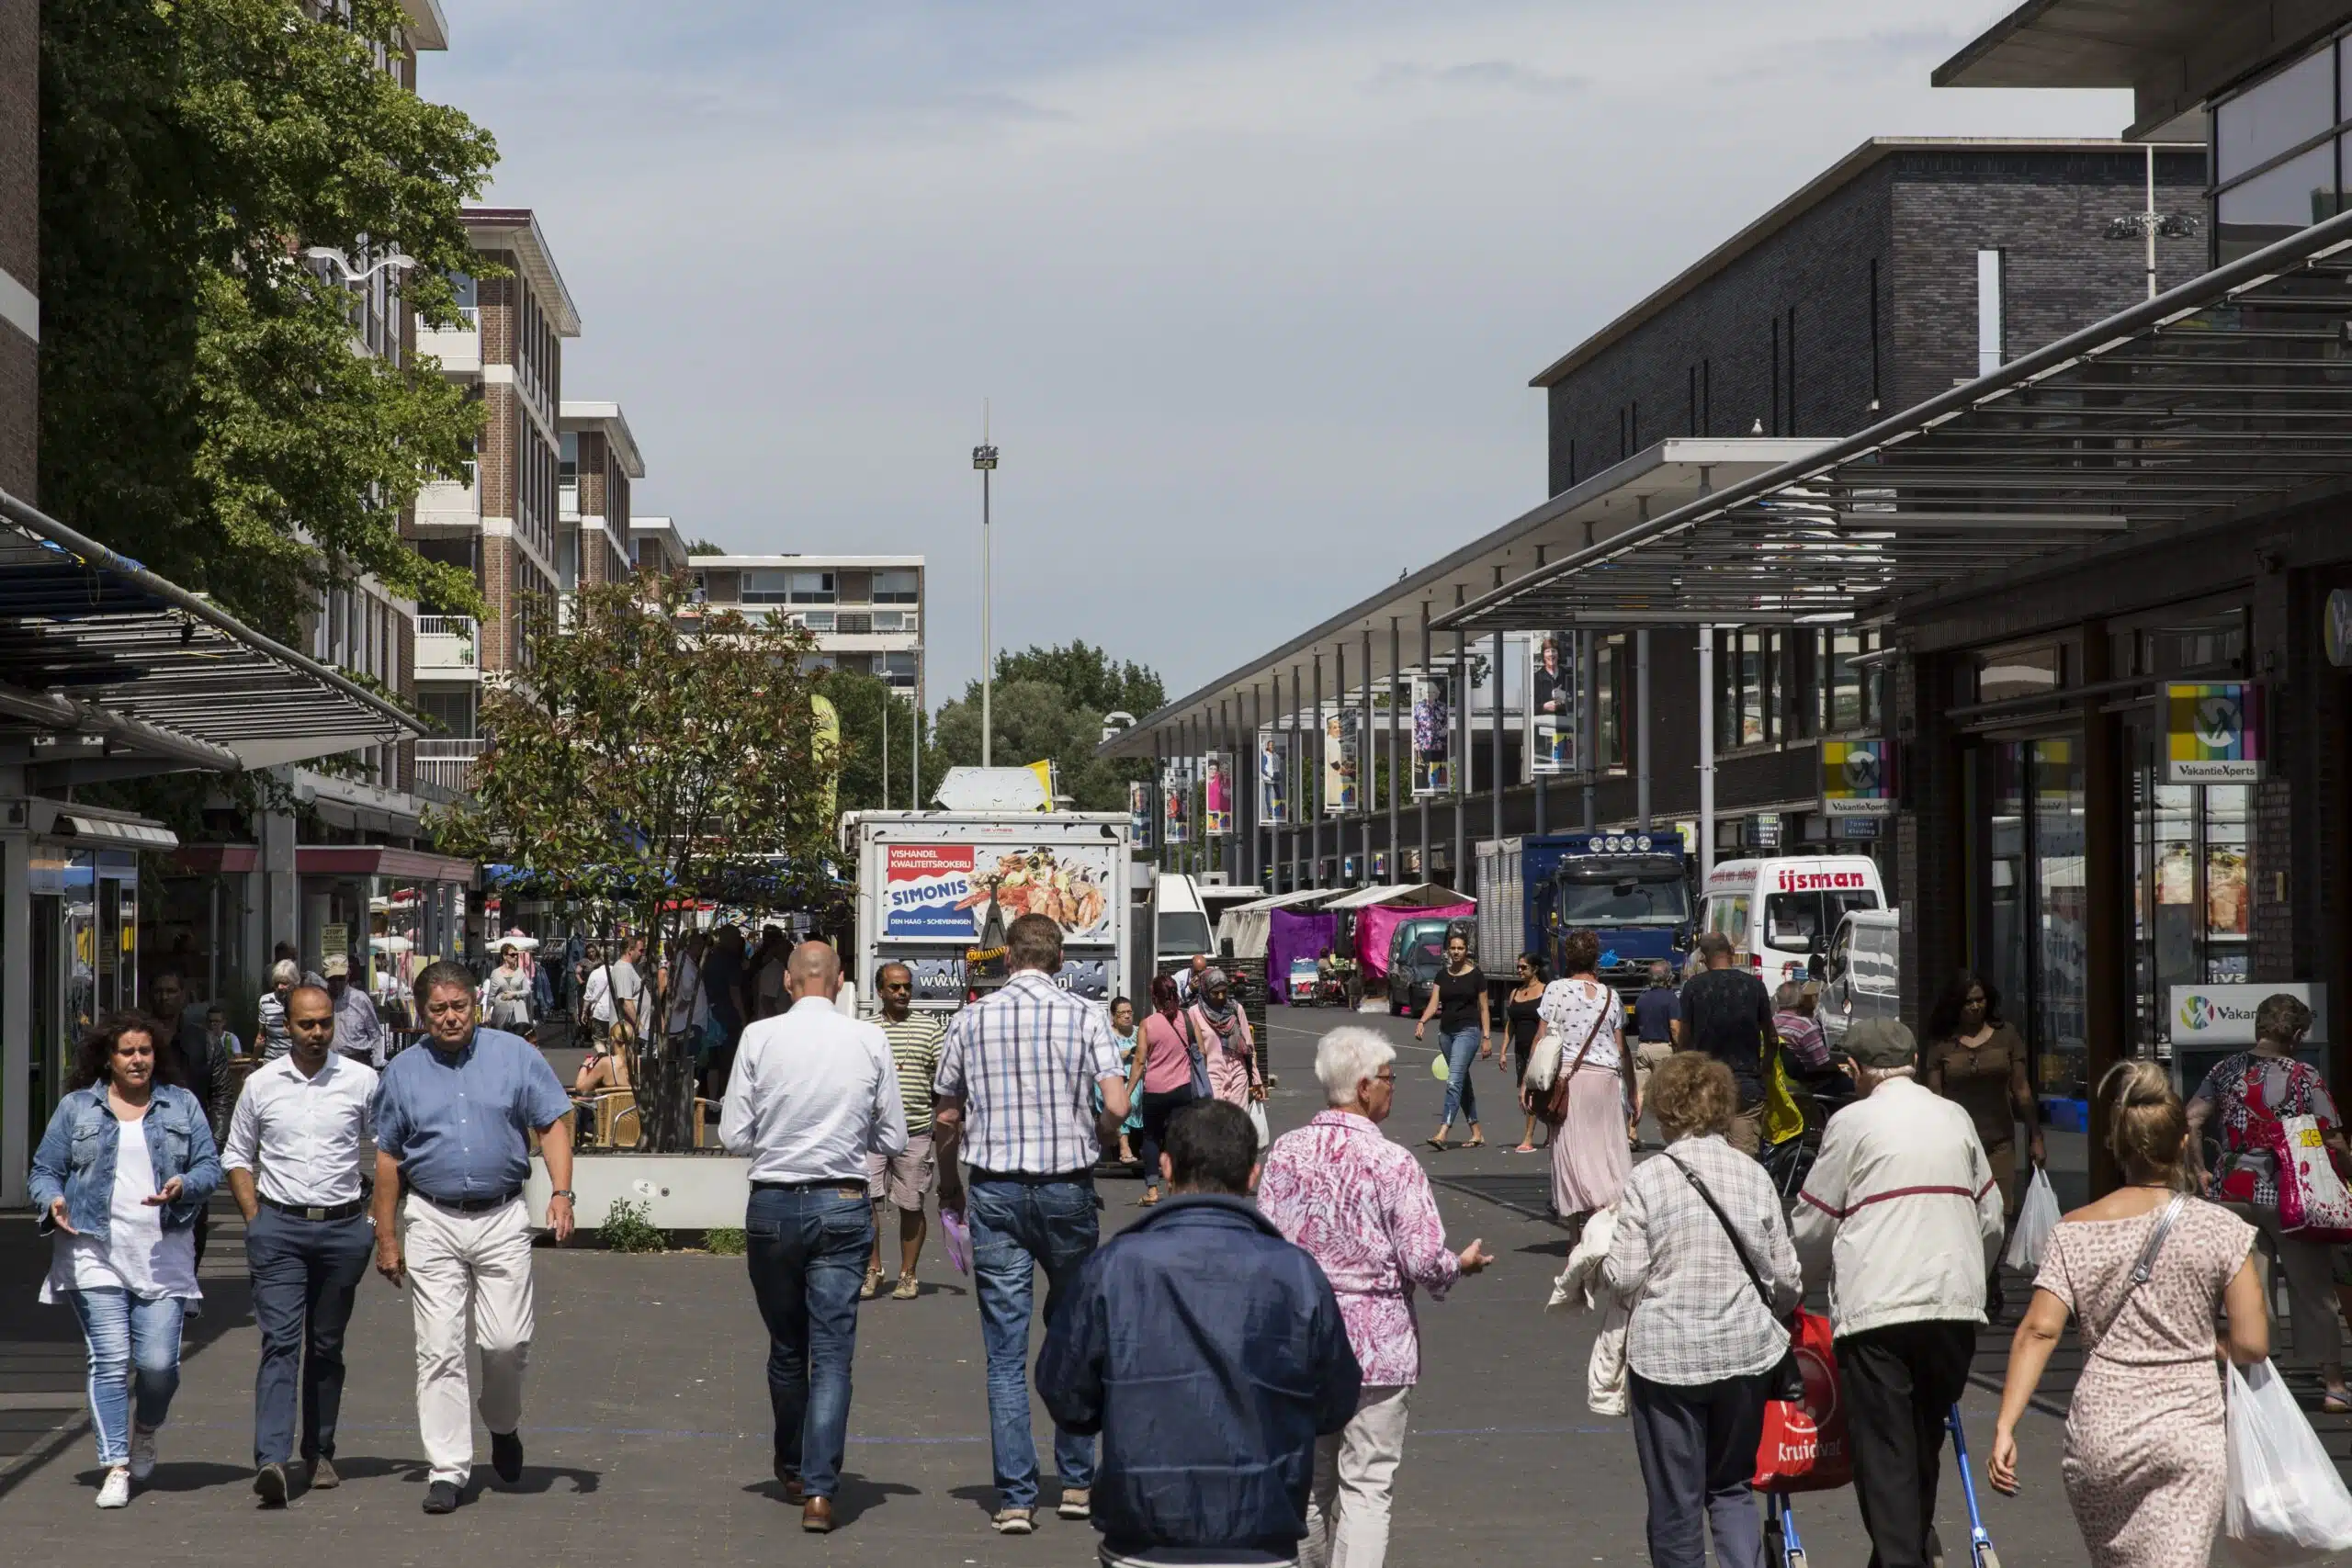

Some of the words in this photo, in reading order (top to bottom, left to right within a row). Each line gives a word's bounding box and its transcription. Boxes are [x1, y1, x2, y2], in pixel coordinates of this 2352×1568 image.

[2179, 764, 2256, 777] VakantieXperts
[1832, 802, 1890, 813] VakantieXperts
[890, 850, 938, 858] VISHANDEL
[890, 860, 971, 868] KWALITEITSROKERIJ
[1779, 869, 1864, 893] ijsman
[891, 879, 968, 906] SIMONIS
[1779, 1437, 1841, 1462] Kruidvat
